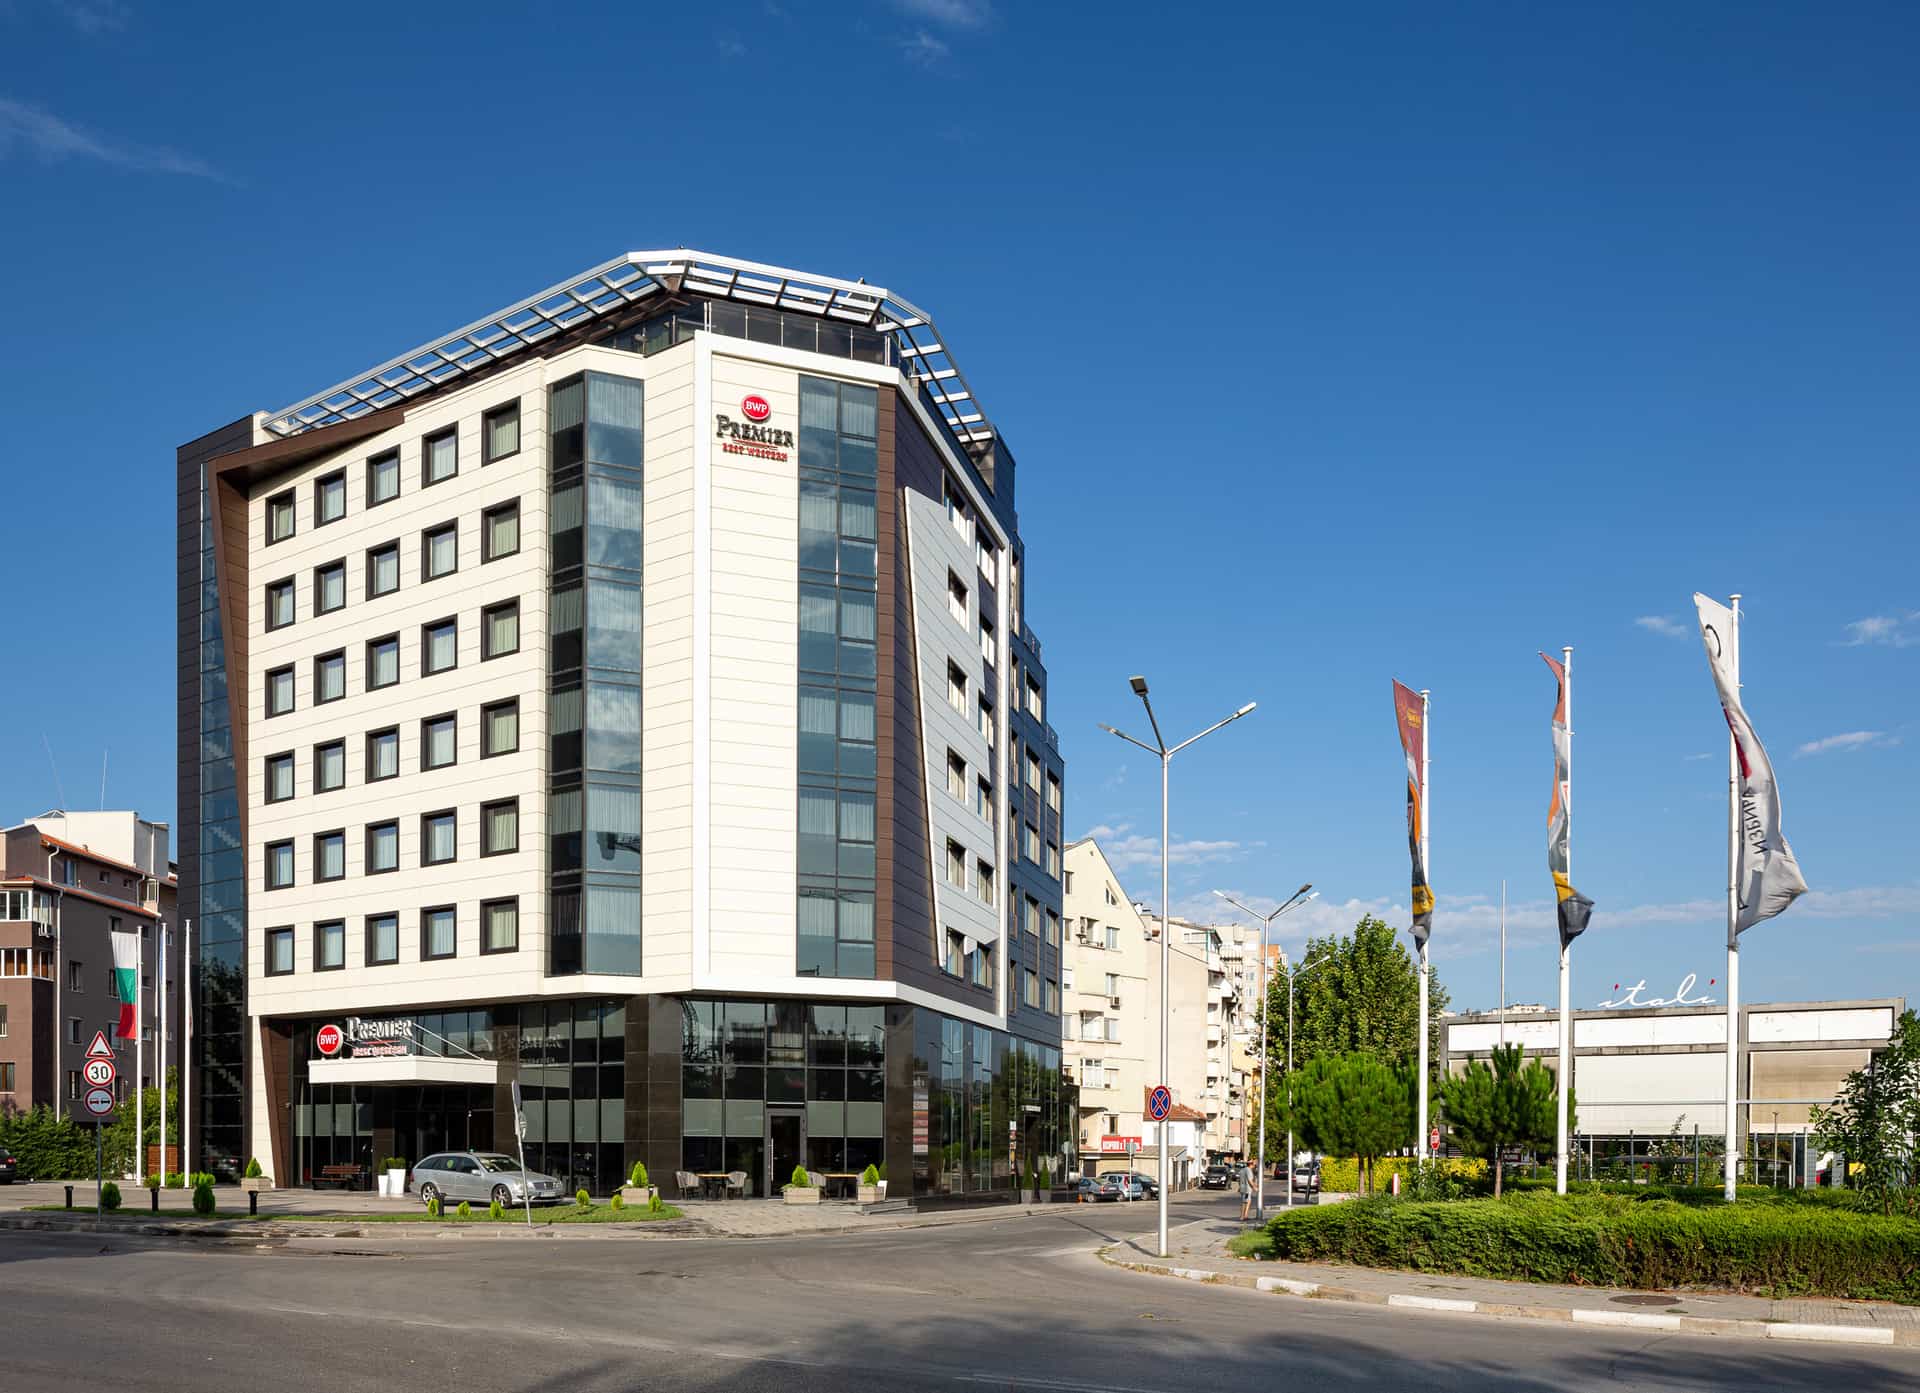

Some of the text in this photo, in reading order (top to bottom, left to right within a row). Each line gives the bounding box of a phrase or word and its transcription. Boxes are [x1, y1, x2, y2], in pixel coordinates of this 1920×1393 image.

[745, 400, 768, 413] BWP
[716, 414, 794, 449] PREMIER
[346, 1017, 413, 1041] PREMIER
[320, 1034, 338, 1045] BWP
[90, 1066, 109, 1080] 30
